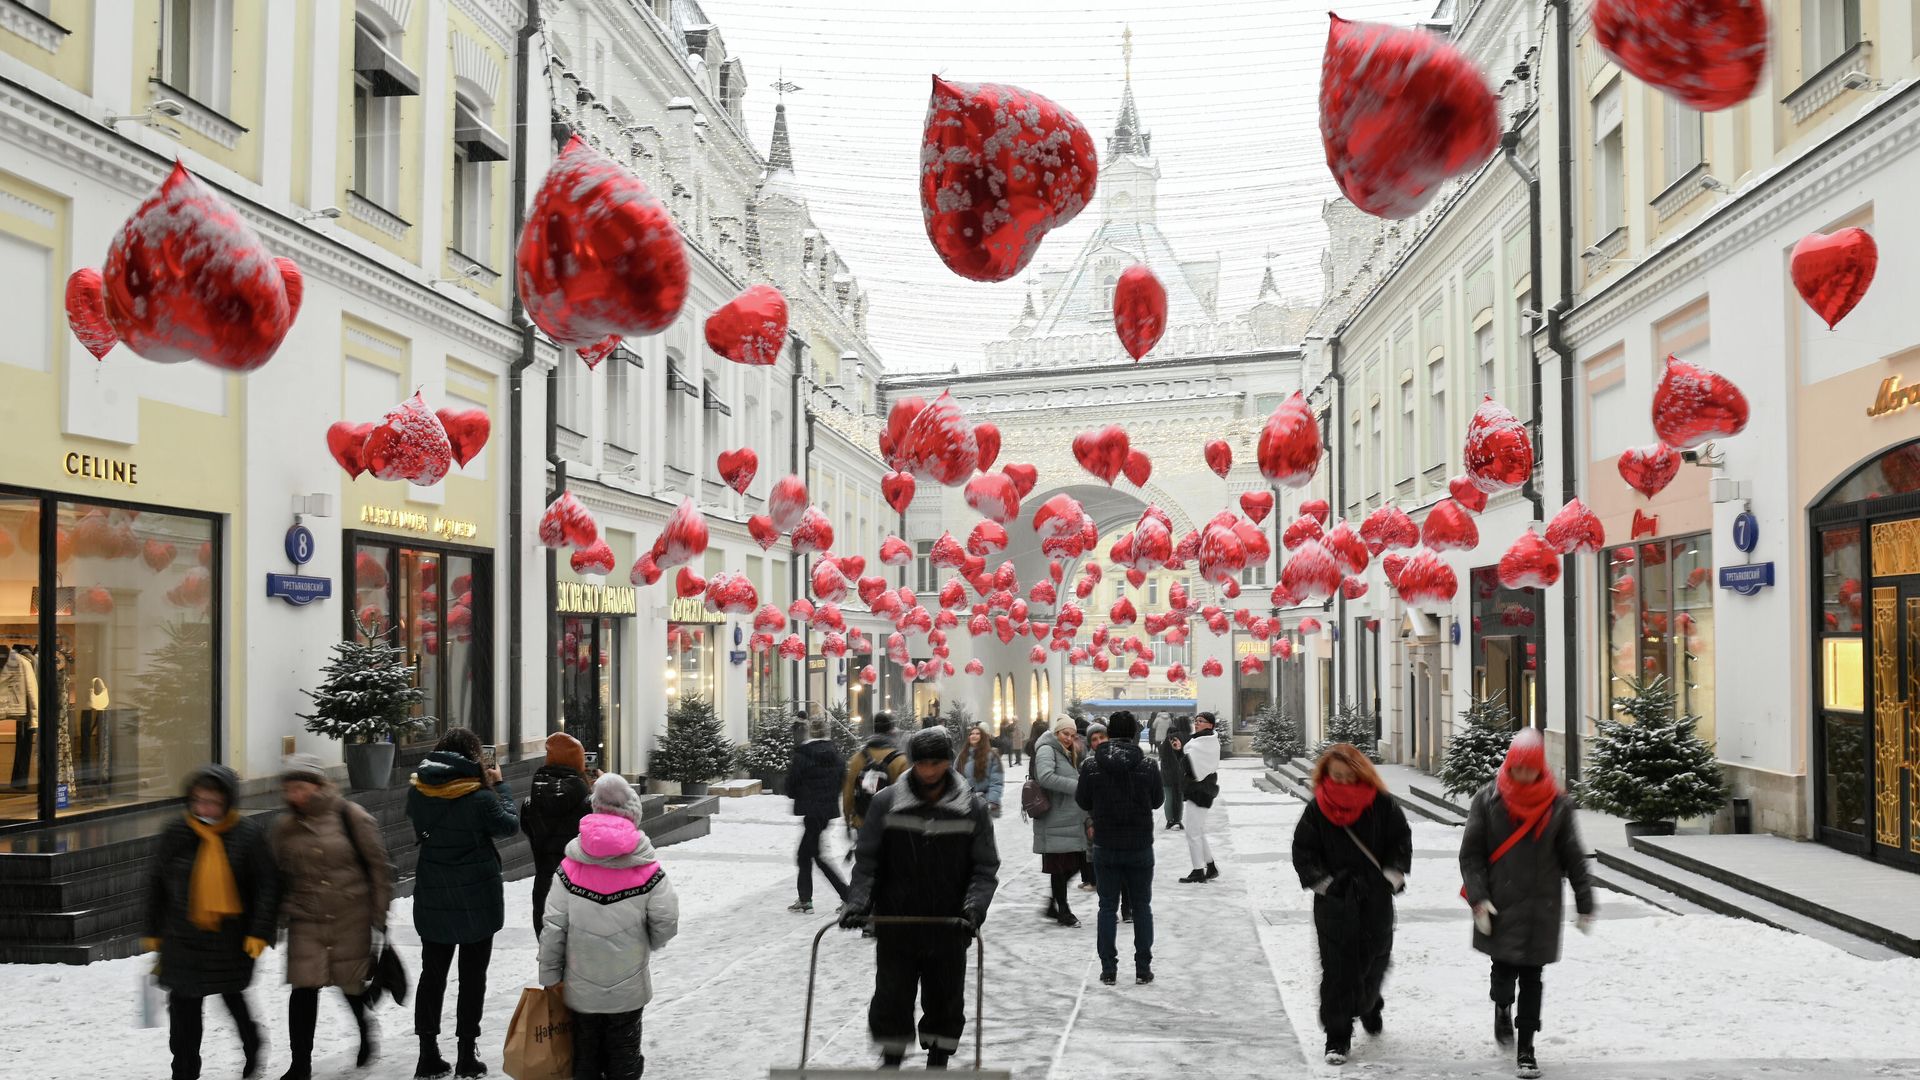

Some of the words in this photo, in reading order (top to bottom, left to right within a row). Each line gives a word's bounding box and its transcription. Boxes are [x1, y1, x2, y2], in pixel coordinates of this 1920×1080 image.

[64, 452, 138, 485] CELINE
[361, 505, 428, 533] ALEXANDER
[299, 533, 308, 558] 8
[1738, 520, 1746, 546] 7
[282, 580, 324, 592] ТРЕТЬЯКОВСКИЙ
[571, 885, 586, 895] PLAY
[587, 891, 602, 901] PLAY
[607, 893, 622, 901] PLAY
[624, 888, 640, 897] PLAY
